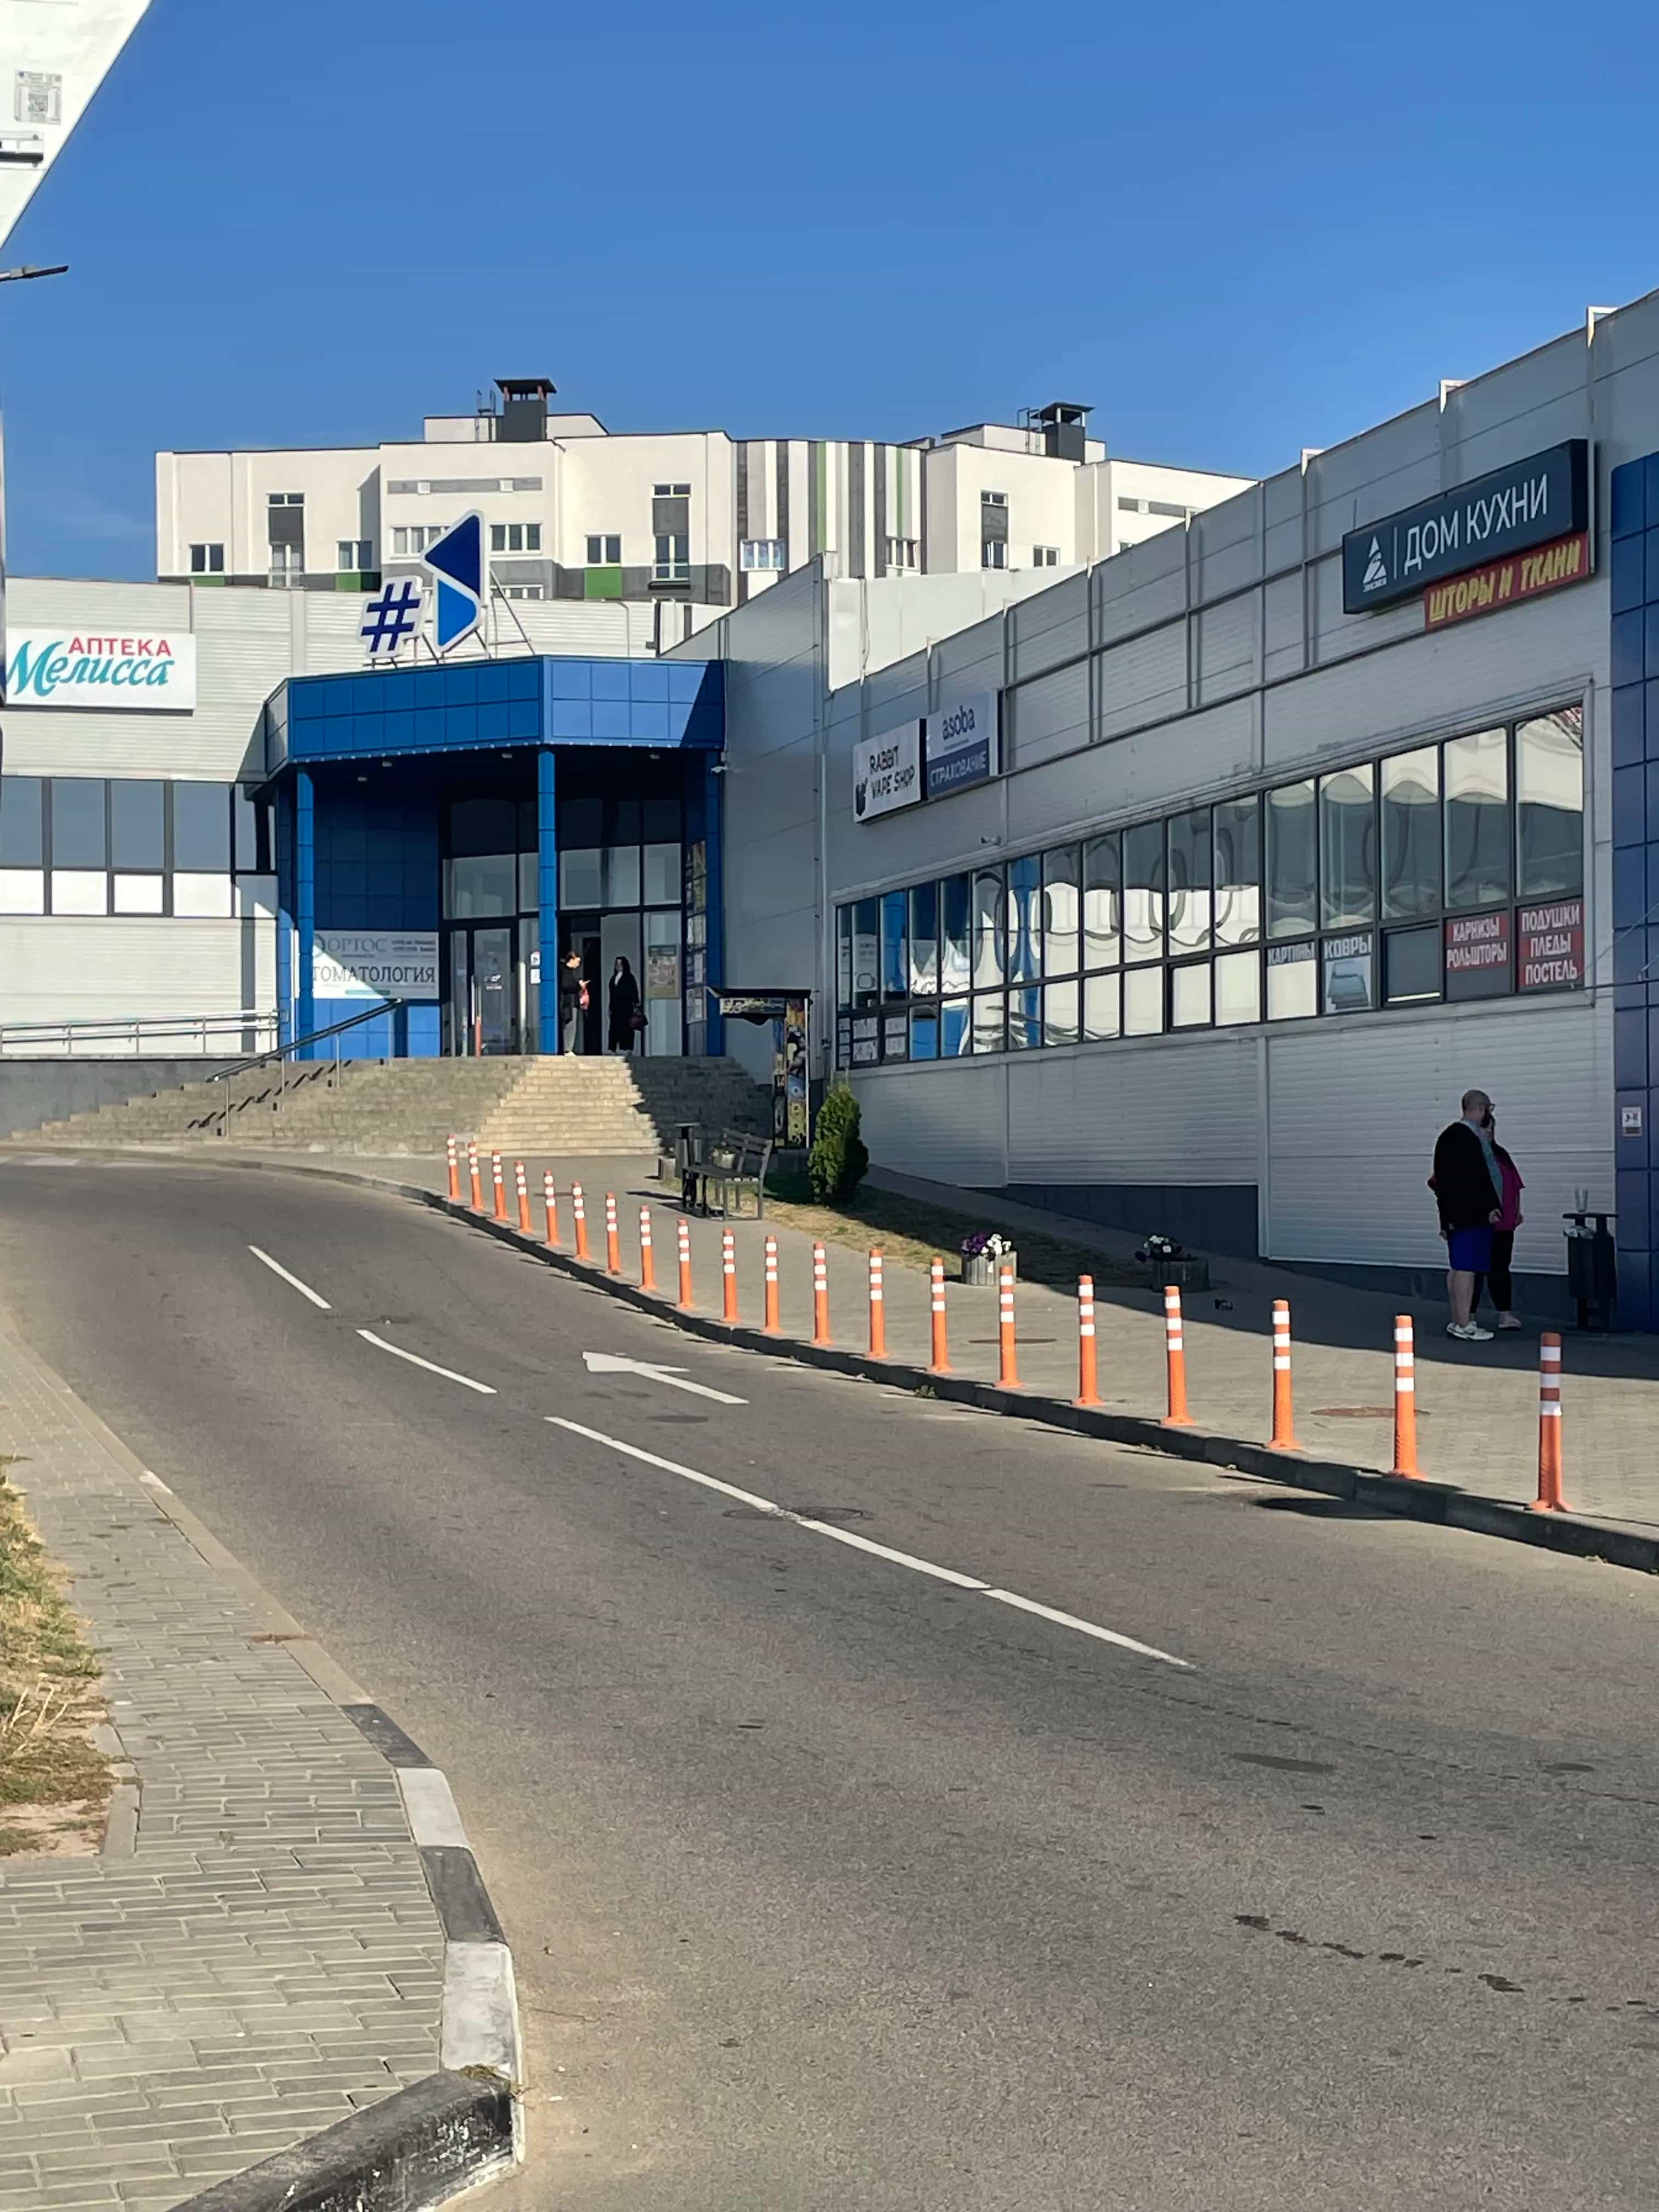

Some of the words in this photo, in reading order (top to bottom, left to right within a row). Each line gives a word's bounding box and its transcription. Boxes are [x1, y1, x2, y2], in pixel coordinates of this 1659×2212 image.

[1404, 510, 1458, 575] ДОМ
[1466, 473, 1548, 545] КУХНИ
[1429, 572, 1496, 622] ШТОРЫ
[1498, 564, 1513, 599] И
[1520, 539, 1582, 591] ТКАНИ
[69, 636, 171, 657] АПТЕКА
[6, 640, 175, 697] Мелисса
[943, 705, 975, 740] asoba
[870, 746, 899, 775] RABBIT
[1453, 917, 1499, 942] КАРНИЗЫ
[1522, 904, 1580, 933] ПОДУШКИ
[1324, 934, 1372, 959] КОВРЫ
[1447, 941, 1507, 969] РОЛЬШТОРЫ
[1531, 932, 1571, 958] ПЛЕДЫ
[313, 966, 435, 983] ТОМАТОЛОГИЯ
[1525, 959, 1578, 985] ПОСТЕЛЬ
